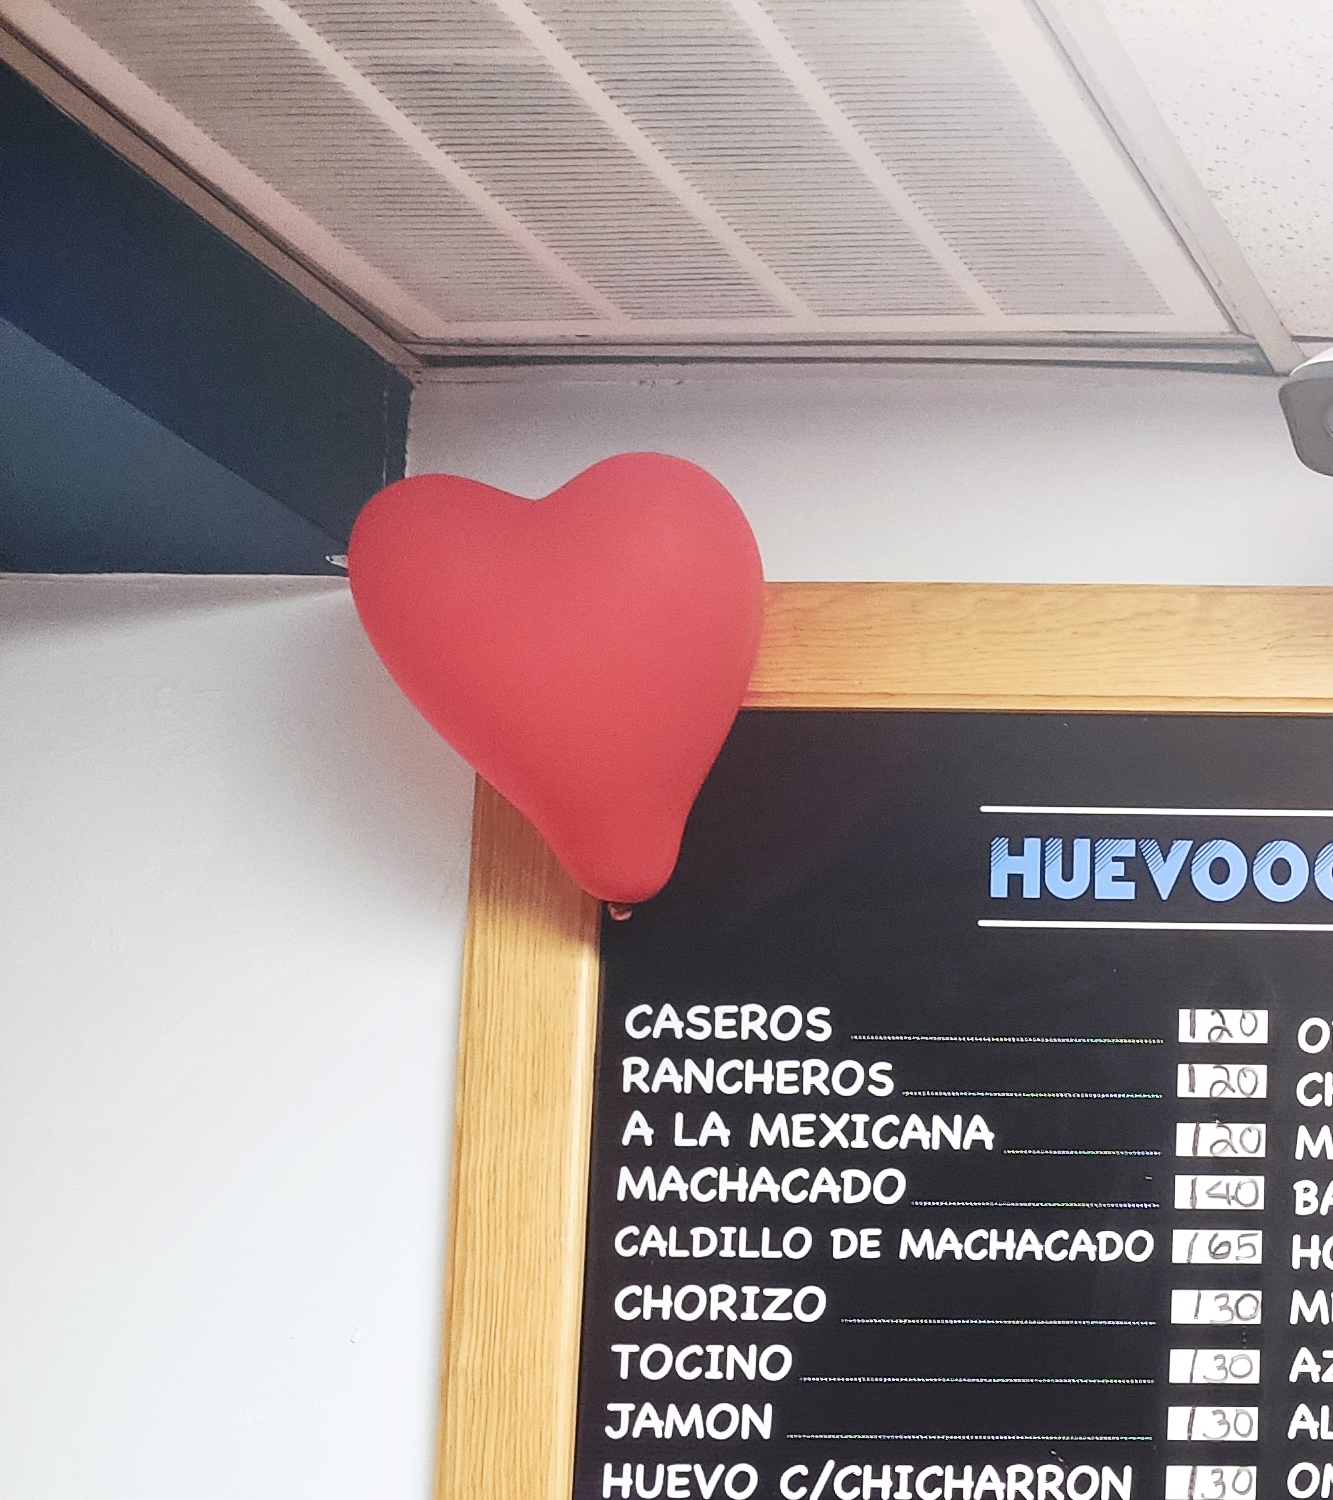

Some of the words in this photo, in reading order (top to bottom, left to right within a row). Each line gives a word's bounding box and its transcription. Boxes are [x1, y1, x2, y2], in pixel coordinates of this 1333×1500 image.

[625, 1004, 832, 1041] CASEROS
[1189, 1009, 1258, 1042] 120
[622, 1057, 894, 1096] RANCHEROS
[1188, 1064, 1258, 1097] 120
[622, 1111, 654, 1146] A
[674, 1111, 730, 1147] LA
[750, 1113, 994, 1150] MEXICANA
[1192, 1123, 1261, 1156] 120
[617, 1166, 906, 1204] MACHACADO
[1190, 1177, 1259, 1209] 140
[615, 1225, 812, 1259] CALDILLO
[831, 1228, 882, 1259] DE
[899, 1228, 1154, 1262] MACHACADO
[1187, 1232, 1259, 1263] 165
[615, 1284, 826, 1322] CHORIZO
[1194, 1291, 1260, 1325] 130
[611, 1343, 792, 1381] TOCINO
[1190, 1349, 1253, 1383] 130
[605, 1402, 772, 1439] JAMON
[1187, 1406, 1253, 1441] 130
[603, 1463, 758, 1500] HUEVO
